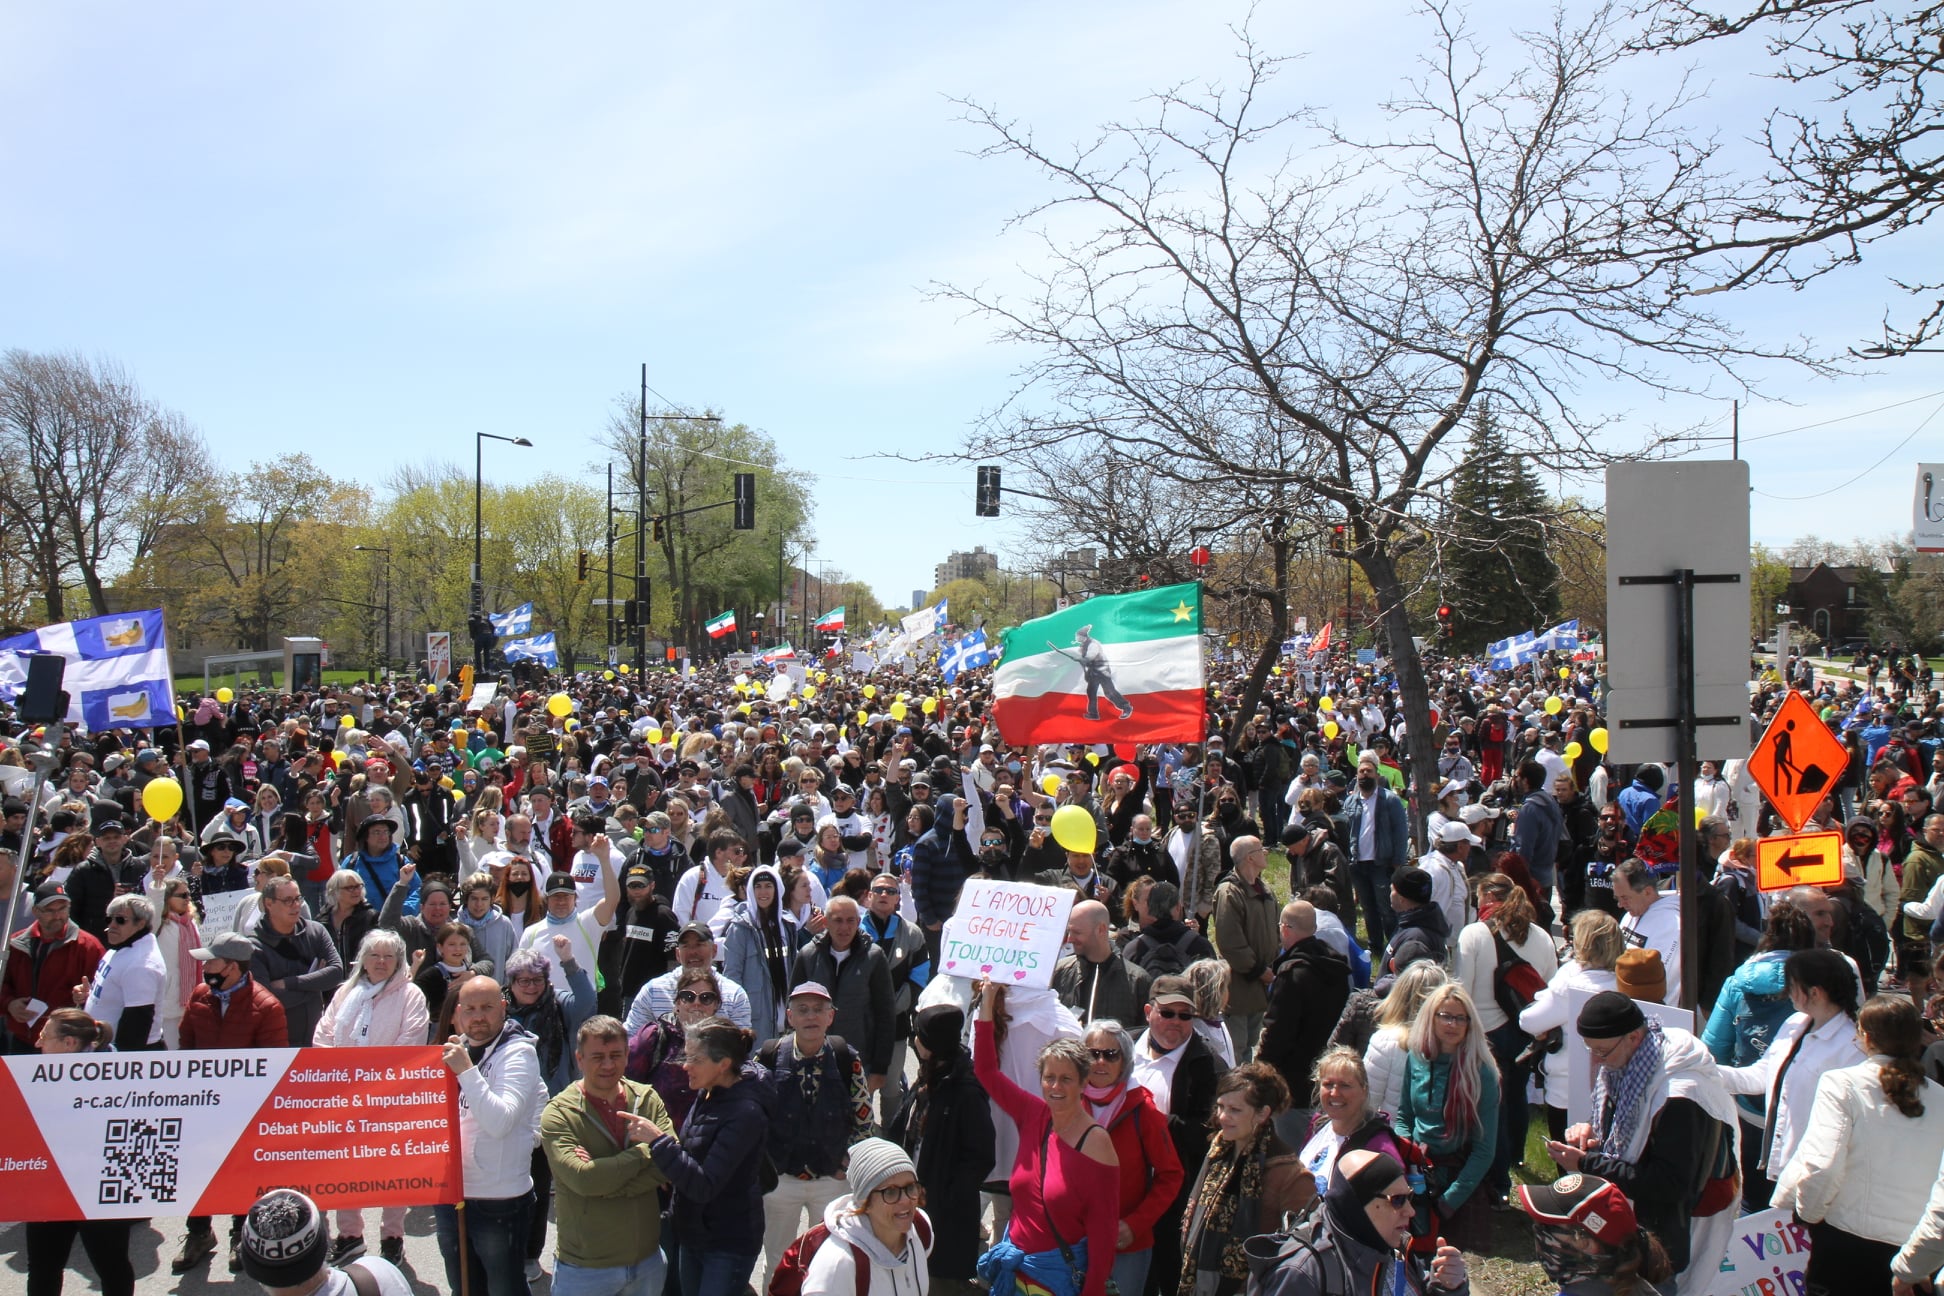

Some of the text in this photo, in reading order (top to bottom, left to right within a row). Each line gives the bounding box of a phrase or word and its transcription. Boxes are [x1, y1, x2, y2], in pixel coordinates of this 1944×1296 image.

[971, 889, 1057, 917] L'AMOUR
[968, 916, 1036, 941] GAGNE
[949, 940, 1040, 969] TOUJOURS
[32, 1058, 268, 1083] AU COEUR DU PEUPLE
[289, 1066, 446, 1084] Solidarité, Paix & Justice
[73, 1089, 221, 1109] a-c.ac/infomanifs
[274, 1095, 349, 1110] Démocratie
[352, 1095, 363, 1107] &
[366, 1091, 447, 1108] Imputabilité
[258, 1118, 448, 1136] Débat Public & Transparence
[253, 1139, 450, 1162] Consentement Libre & Éclairé
[0, 1157, 48, 1172] Libertés
[315, 1177, 433, 1194] COORDINATION
